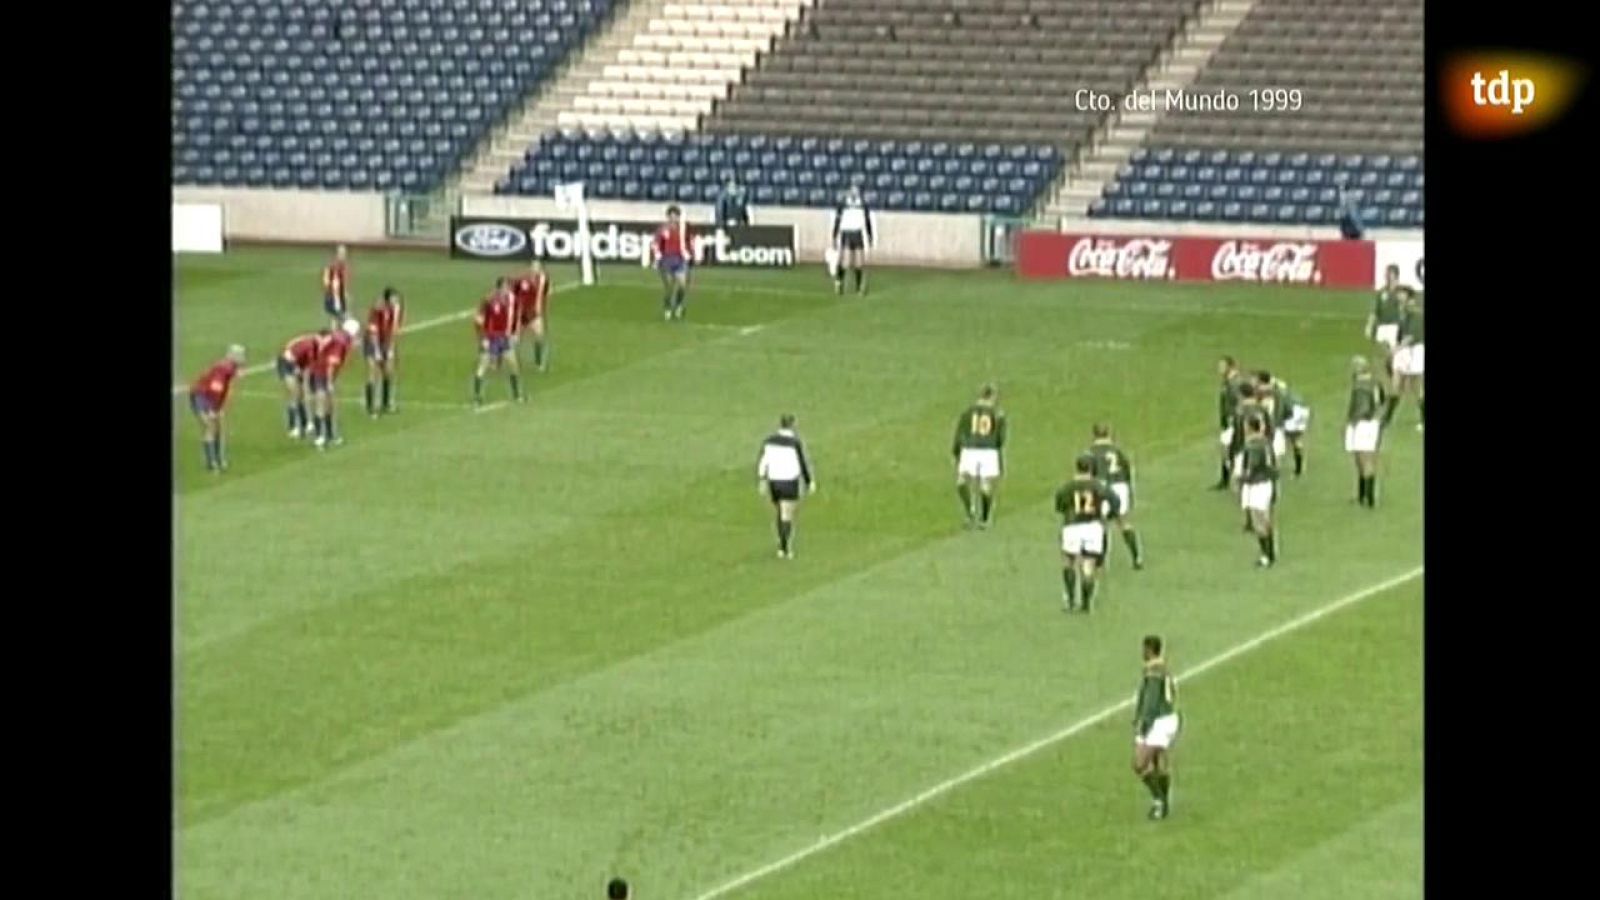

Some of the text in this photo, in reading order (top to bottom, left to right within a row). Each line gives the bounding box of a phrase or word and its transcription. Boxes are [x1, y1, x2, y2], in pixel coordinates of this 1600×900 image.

[971, 413, 992, 436] 10
[1105, 451, 1121, 474] 2
[1073, 490, 1096, 515] 12
